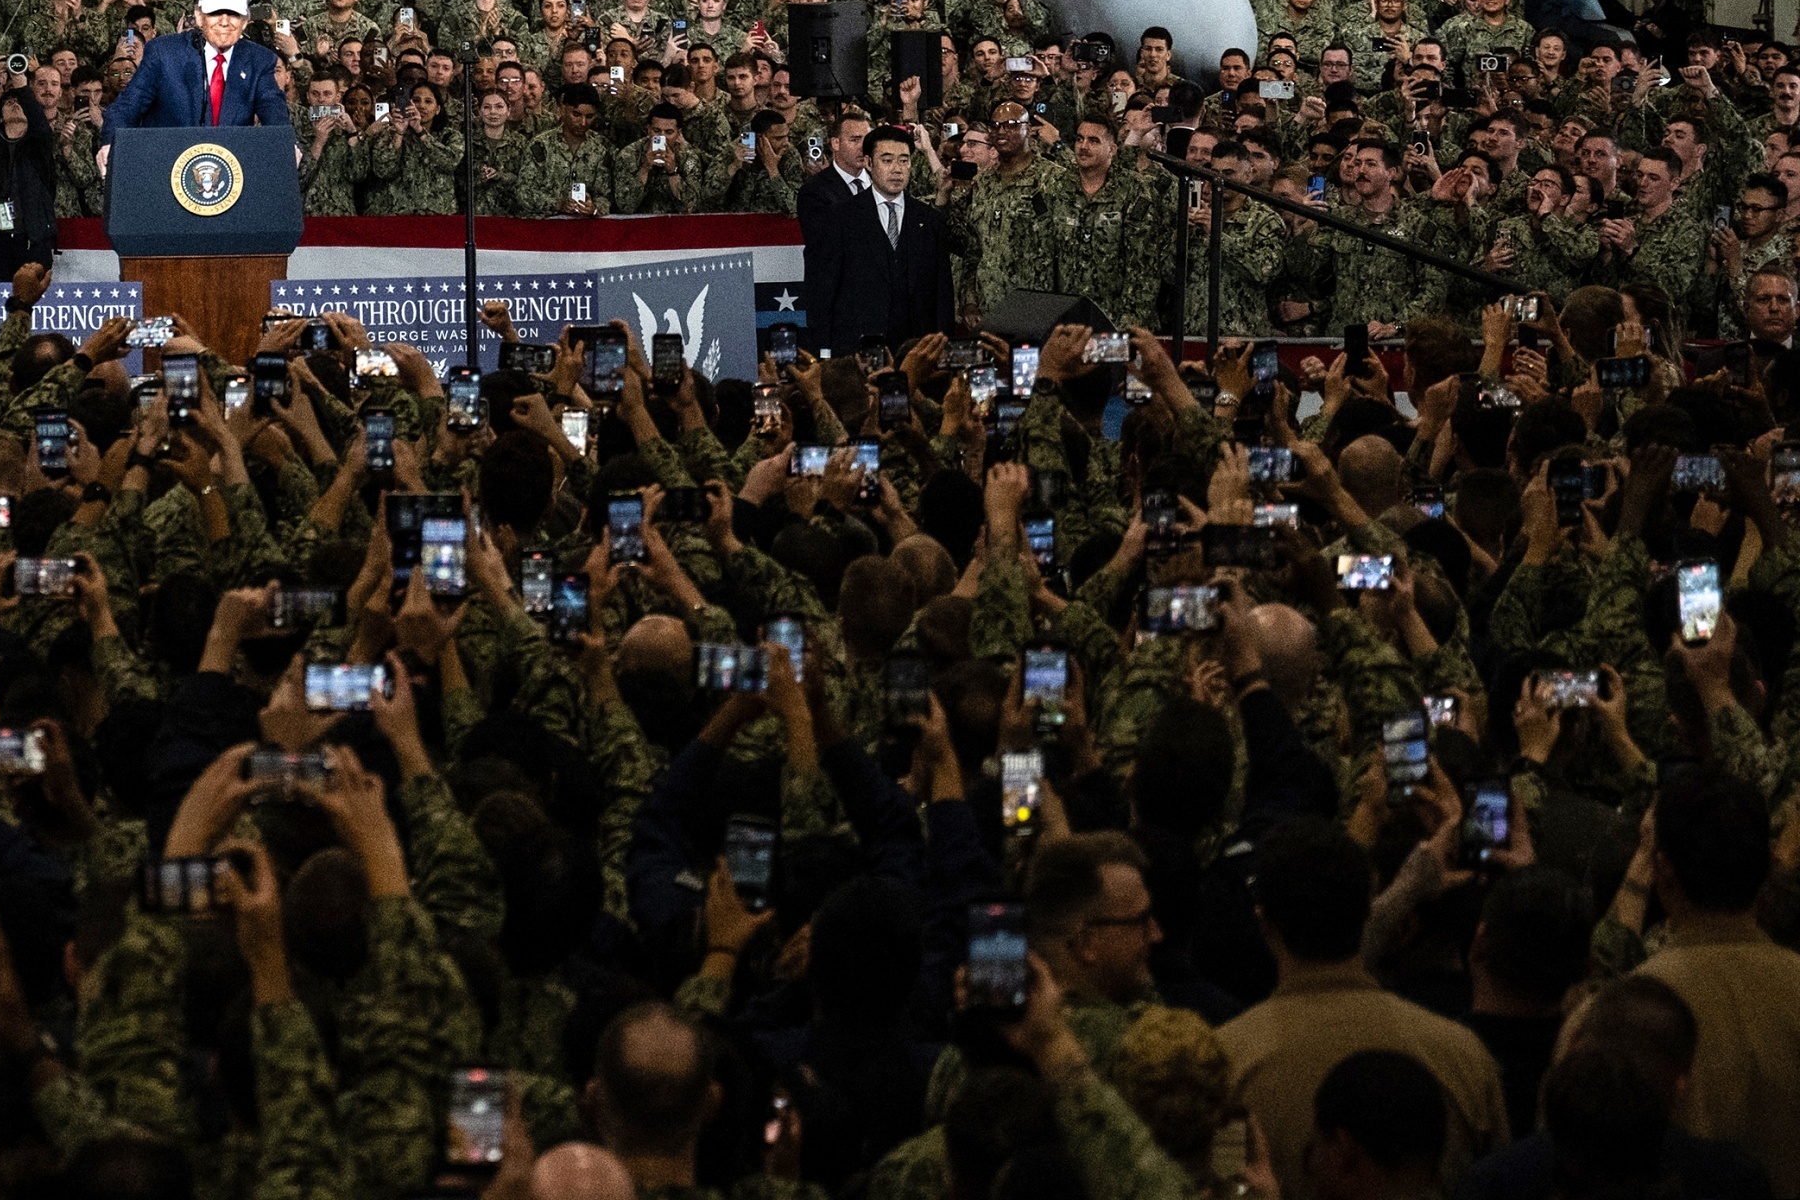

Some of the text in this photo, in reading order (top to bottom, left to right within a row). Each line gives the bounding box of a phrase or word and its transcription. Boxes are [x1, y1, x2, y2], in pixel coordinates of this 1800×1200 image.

[173, 146, 205, 179] PRESIDENT
[225, 154, 241, 184] UNITED
[214, 189, 238, 212] STATES
[31, 304, 136, 331] TRENGTH
[353, 298, 467, 326] THROUGH
[367, 327, 540, 342] GEORGE WASINON
[452, 343, 487, 353] JAN
